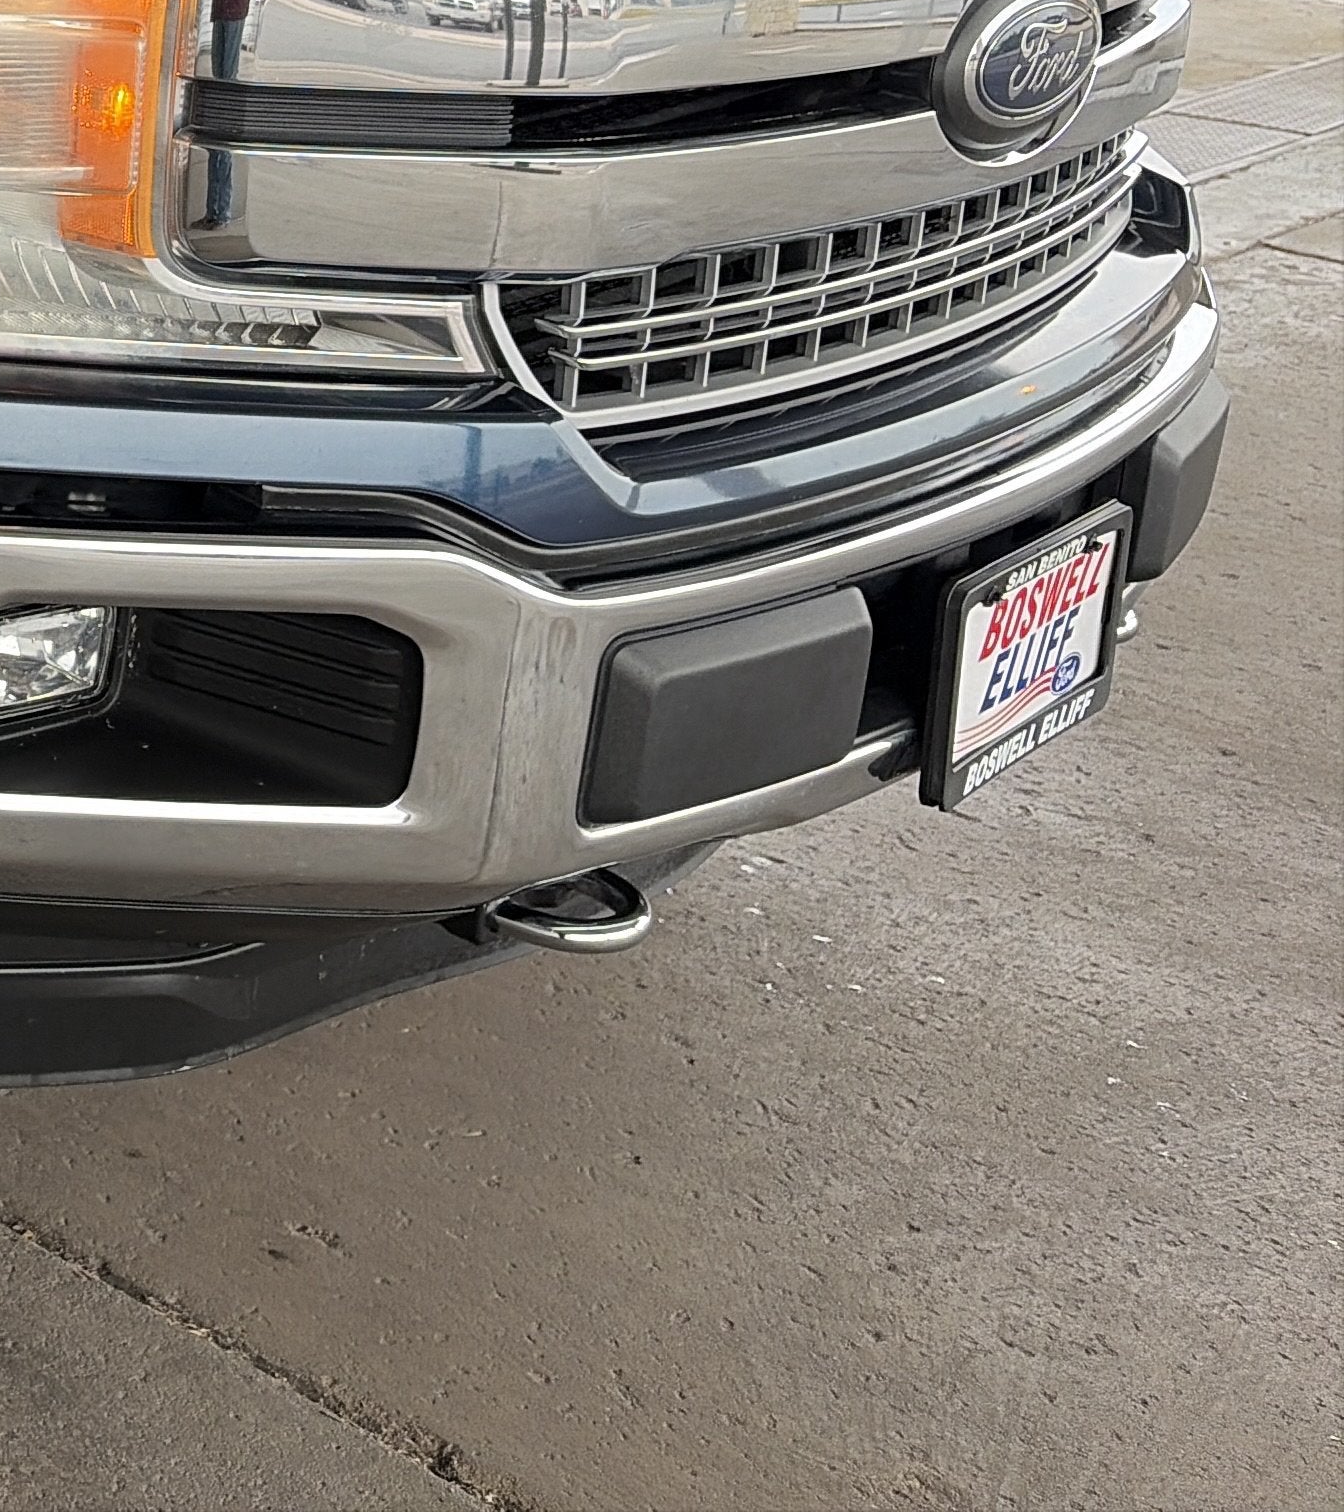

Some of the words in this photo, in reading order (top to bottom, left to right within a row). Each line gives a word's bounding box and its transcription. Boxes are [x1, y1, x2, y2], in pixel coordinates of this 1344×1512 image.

[1008, 18, 1084, 102] Ford
[979, 544, 1109, 663] BOSWELL
[1006, 559, 1037, 591] SAN
[1039, 534, 1087, 574] BENITO
[979, 608, 1082, 714] ELLIFF
[962, 733, 1036, 796] BOSWELL
[1038, 688, 1096, 746] ELLIFF
